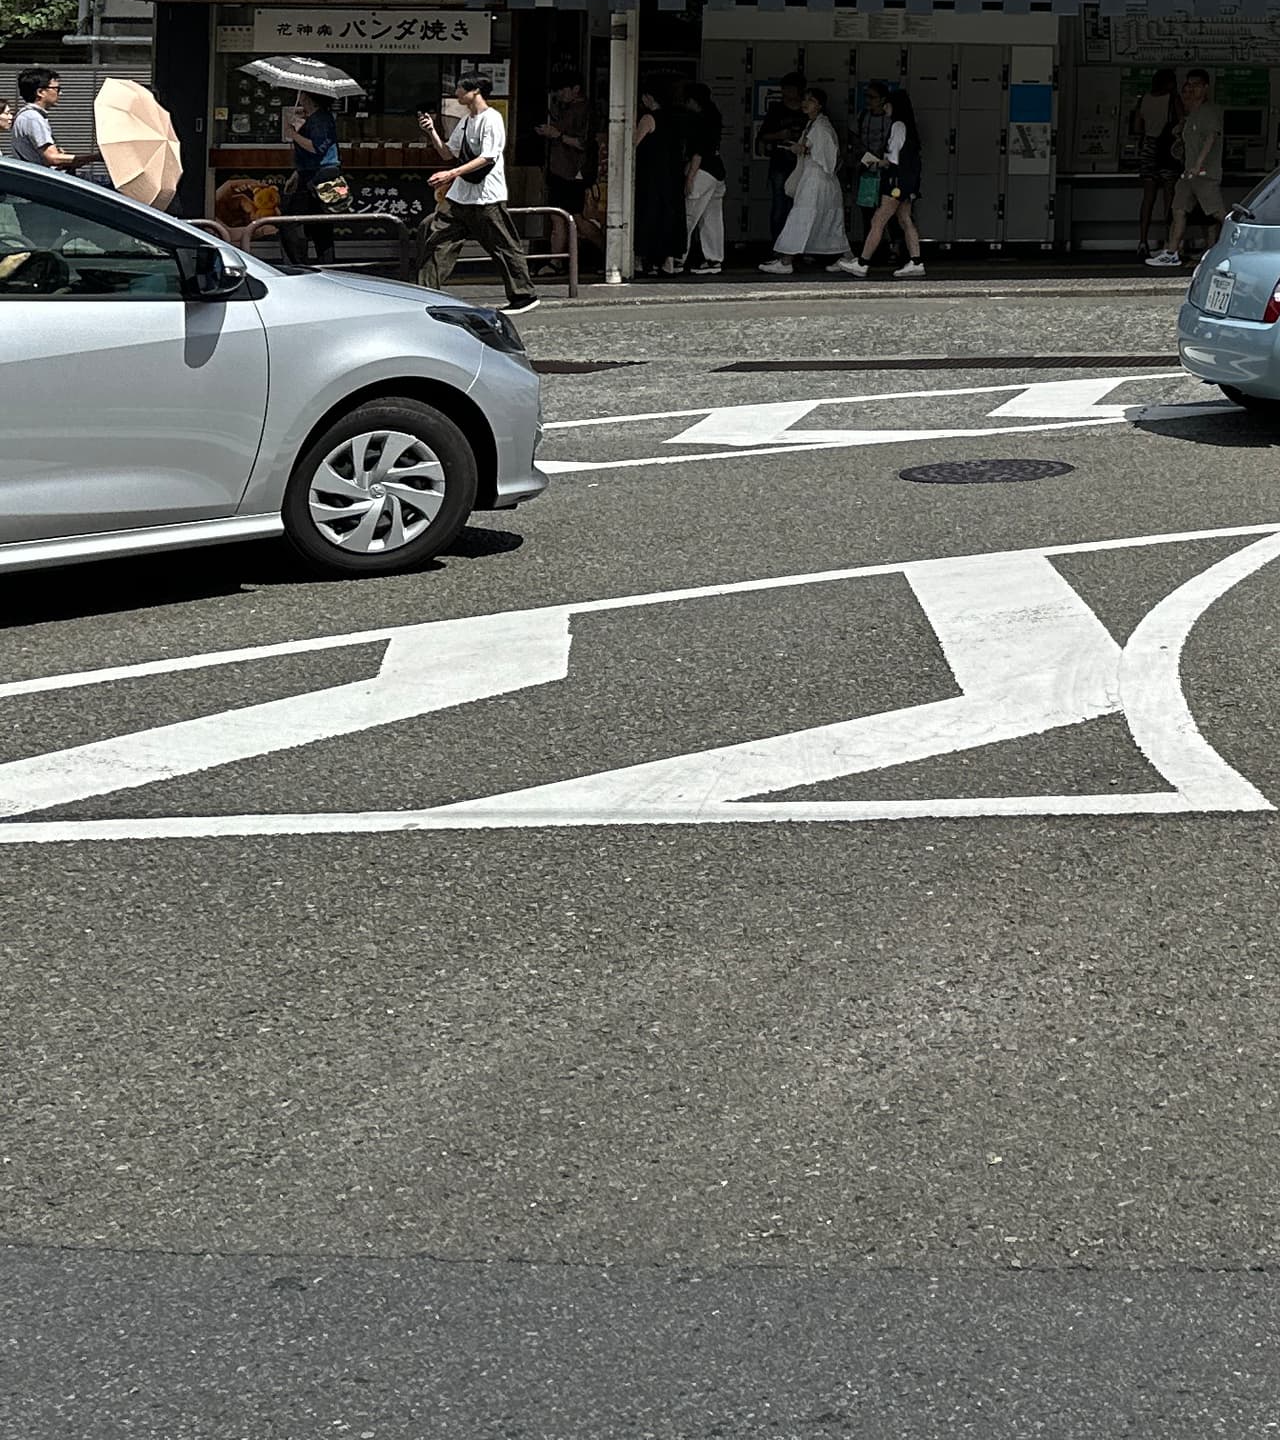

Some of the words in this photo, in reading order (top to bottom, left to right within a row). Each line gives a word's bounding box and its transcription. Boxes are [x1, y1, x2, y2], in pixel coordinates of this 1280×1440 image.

[339, 18, 470, 41] パンダ焼き
